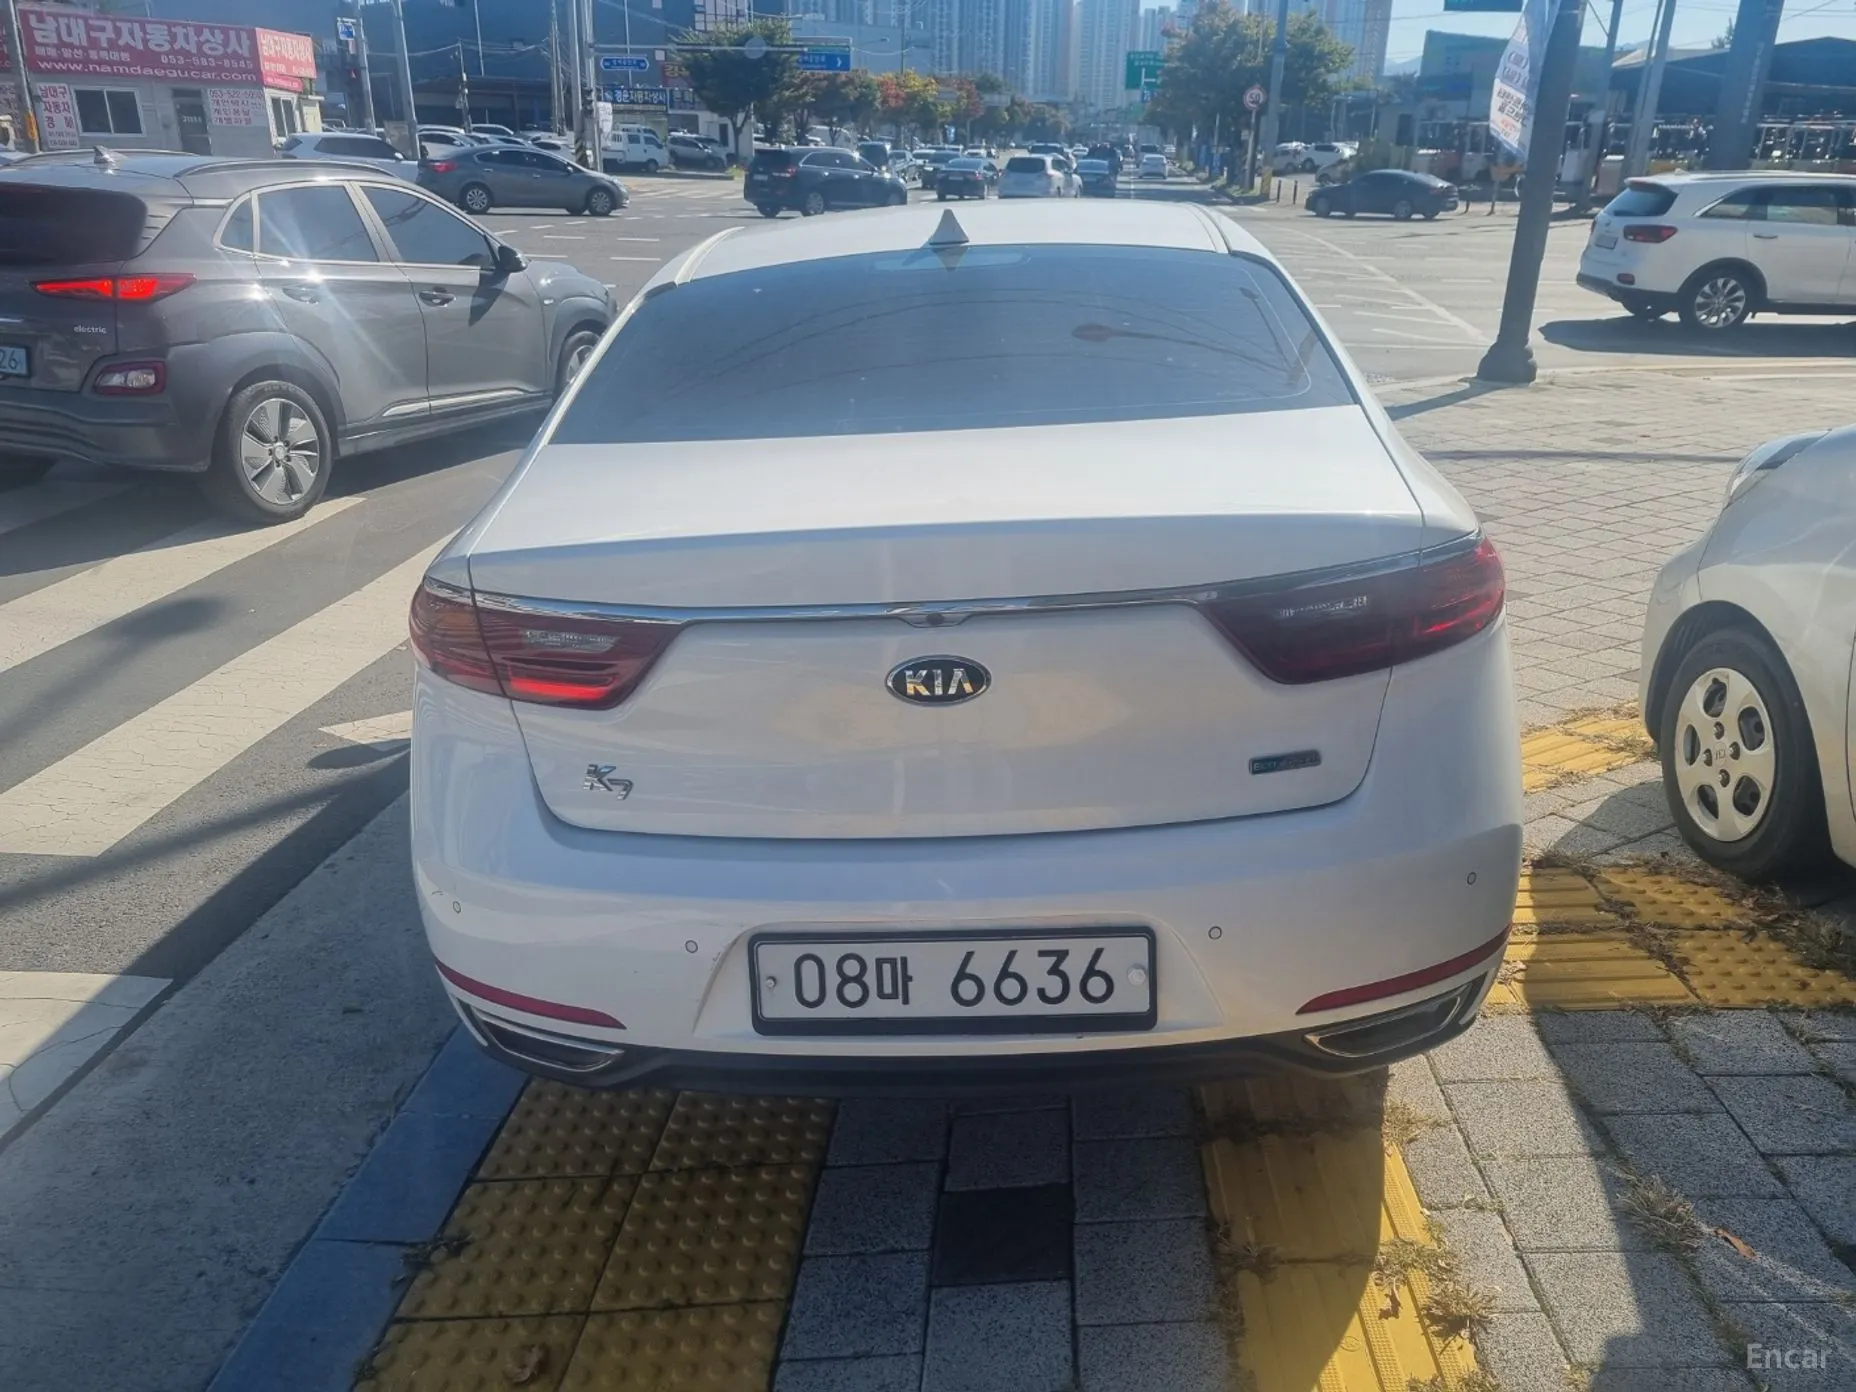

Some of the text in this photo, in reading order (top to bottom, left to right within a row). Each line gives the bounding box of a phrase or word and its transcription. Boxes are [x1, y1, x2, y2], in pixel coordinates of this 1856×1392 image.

[29, 13, 251, 58] 남대구자동차상사
[37, 60, 257, 82] www.namdaegucar.com
[40, 85, 68, 99] 남대구
[43, 101, 72, 114] 자동차
[73, 325, 107, 334] electric
[904, 668, 974, 696] KIA
[585, 763, 634, 801] K7
[794, 947, 1114, 1009] 08마 6636
